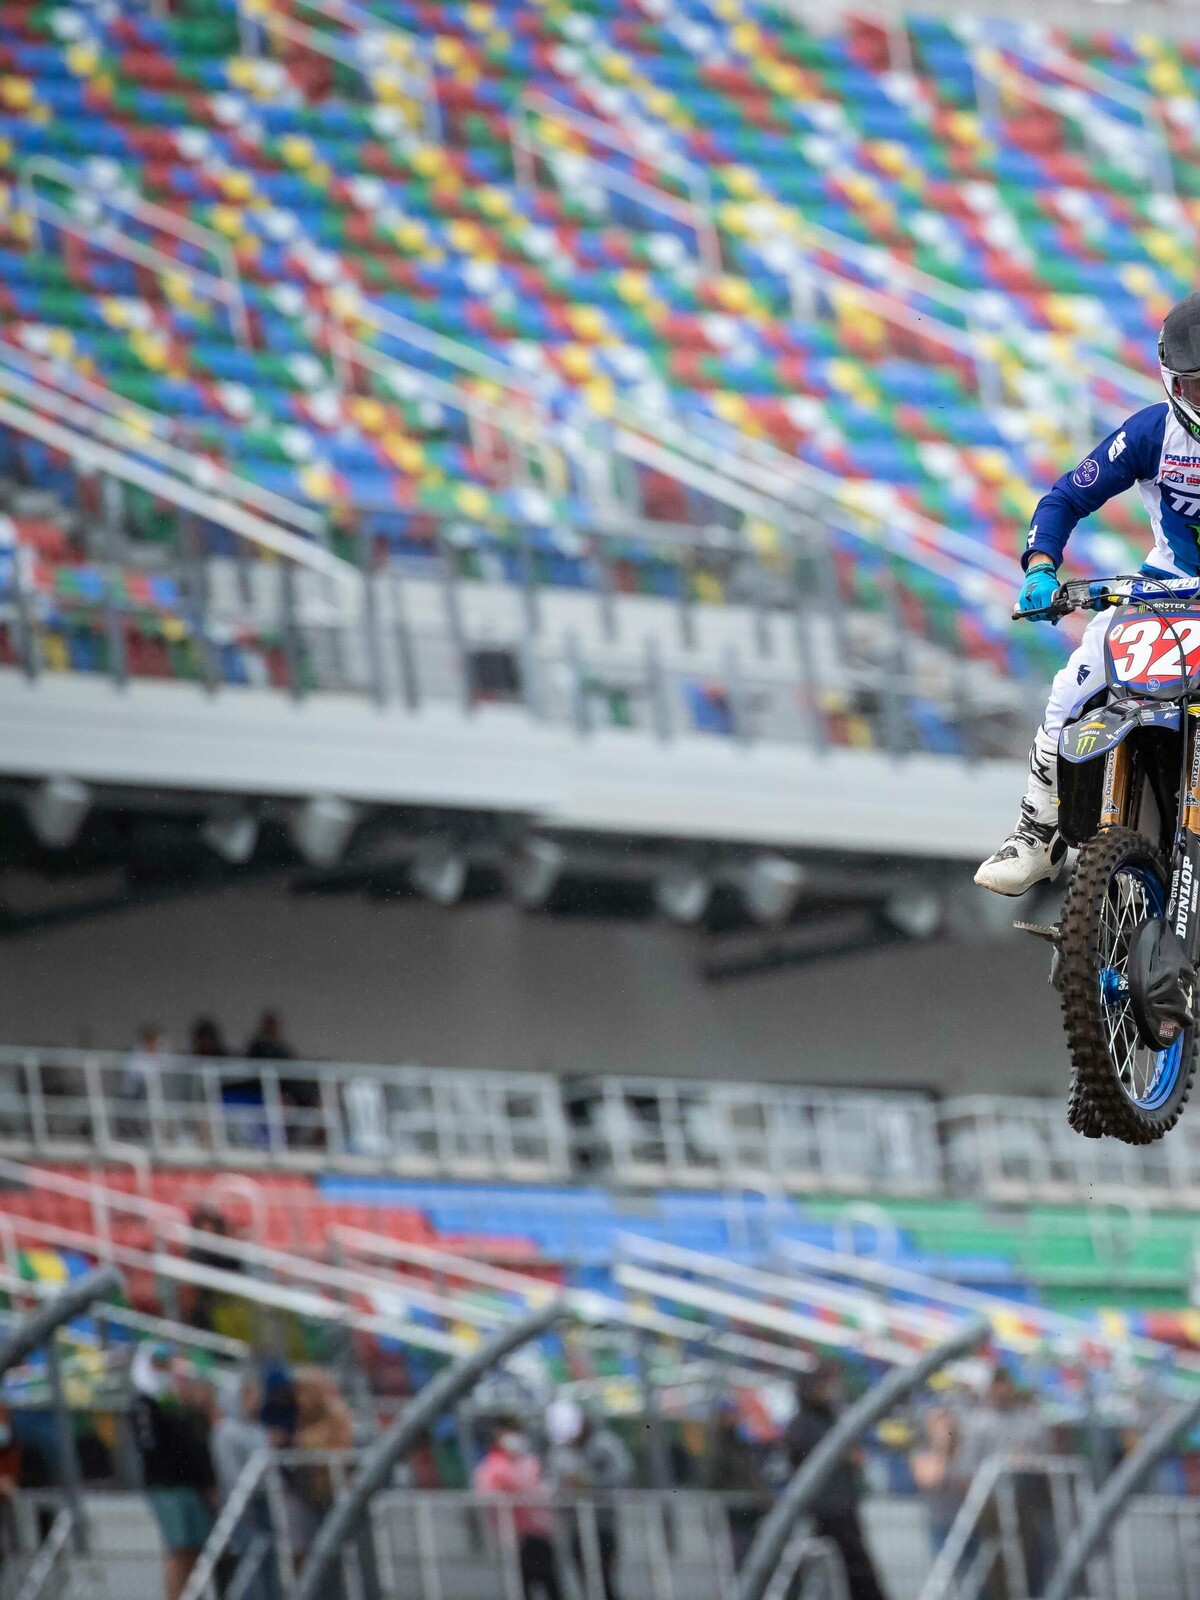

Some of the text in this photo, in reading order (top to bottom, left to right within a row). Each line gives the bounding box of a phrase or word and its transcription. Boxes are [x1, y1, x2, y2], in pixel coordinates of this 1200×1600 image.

[1078, 730, 1100, 738] YAMAHA
[1170, 869, 1180, 899] CYCRA
[1175, 855, 1194, 939] DUNLOP
[1190, 878, 1200, 914] BRAKING
[1160, 1029, 1174, 1037] SPEED
